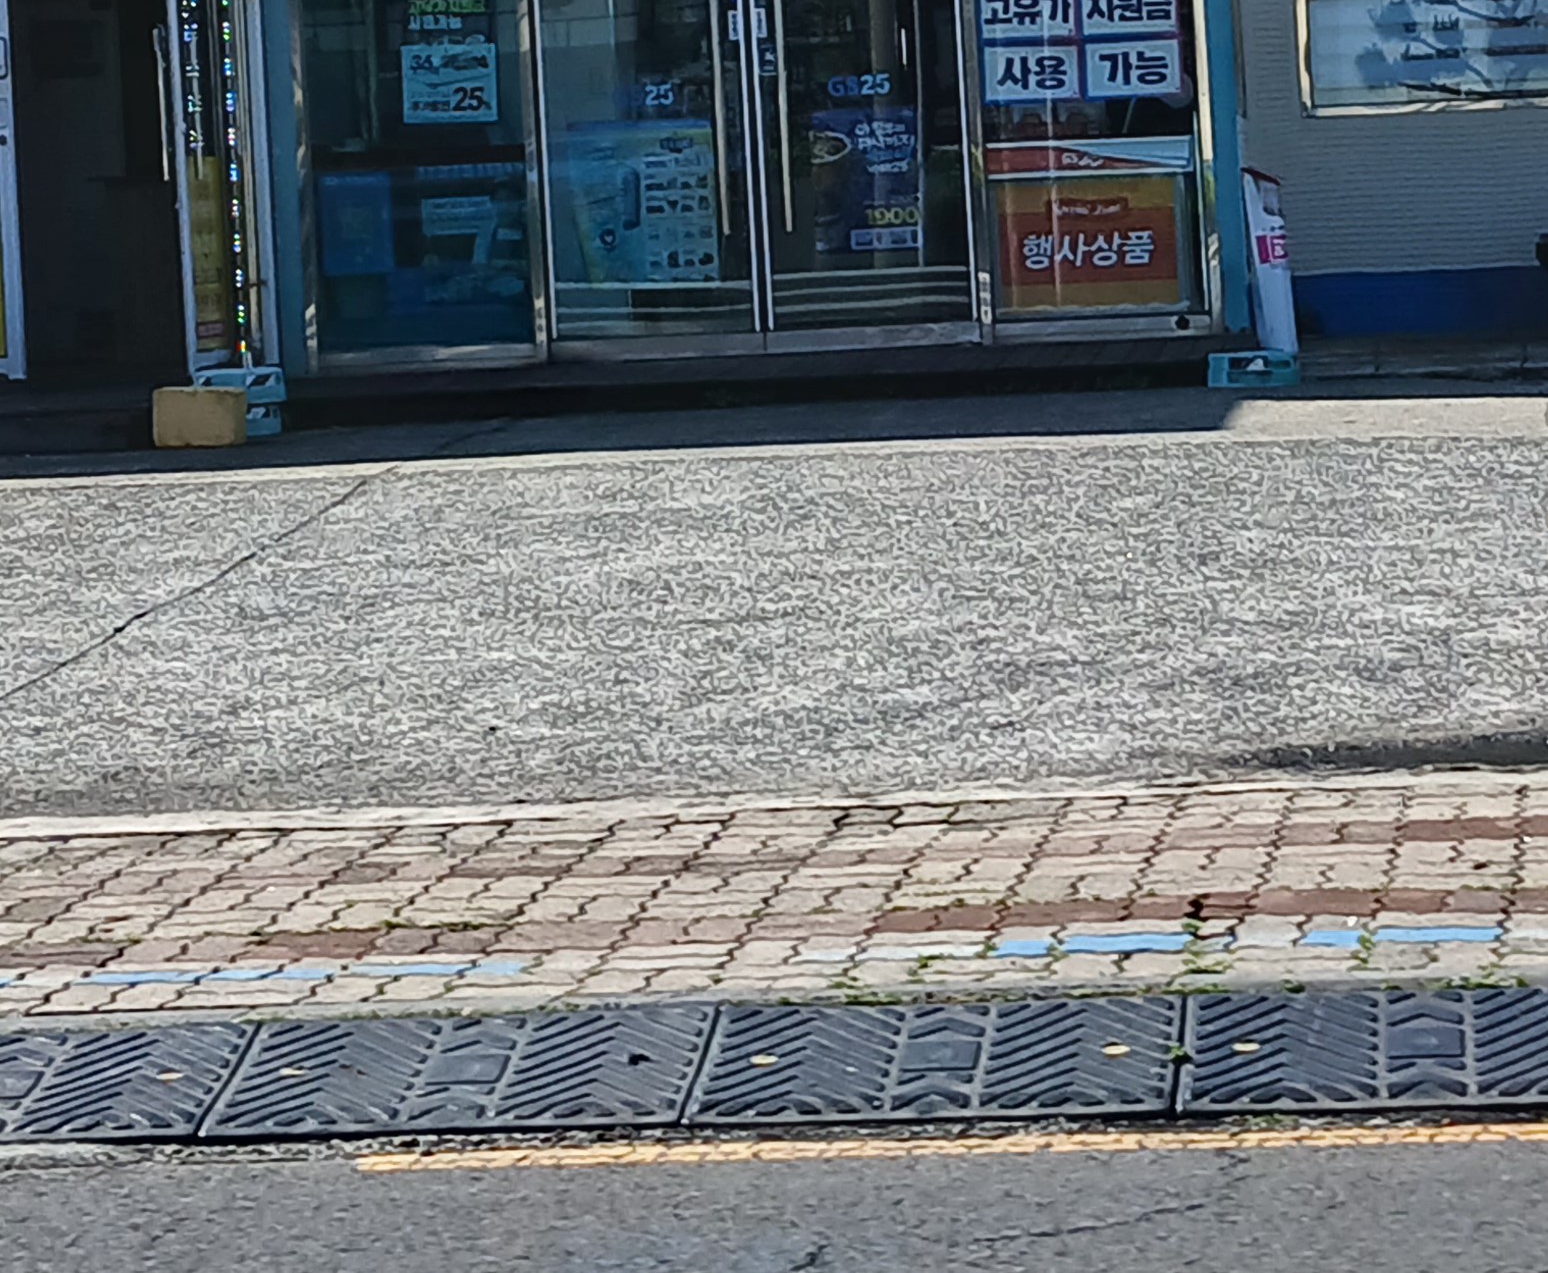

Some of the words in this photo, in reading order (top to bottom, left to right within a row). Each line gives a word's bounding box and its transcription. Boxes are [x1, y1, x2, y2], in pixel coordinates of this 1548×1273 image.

[827, 73, 891, 97] GS25
[996, 55, 1068, 90] 사용
[1098, 50, 1169, 86] 가능
[1022, 230, 1155, 269] 행사상품
